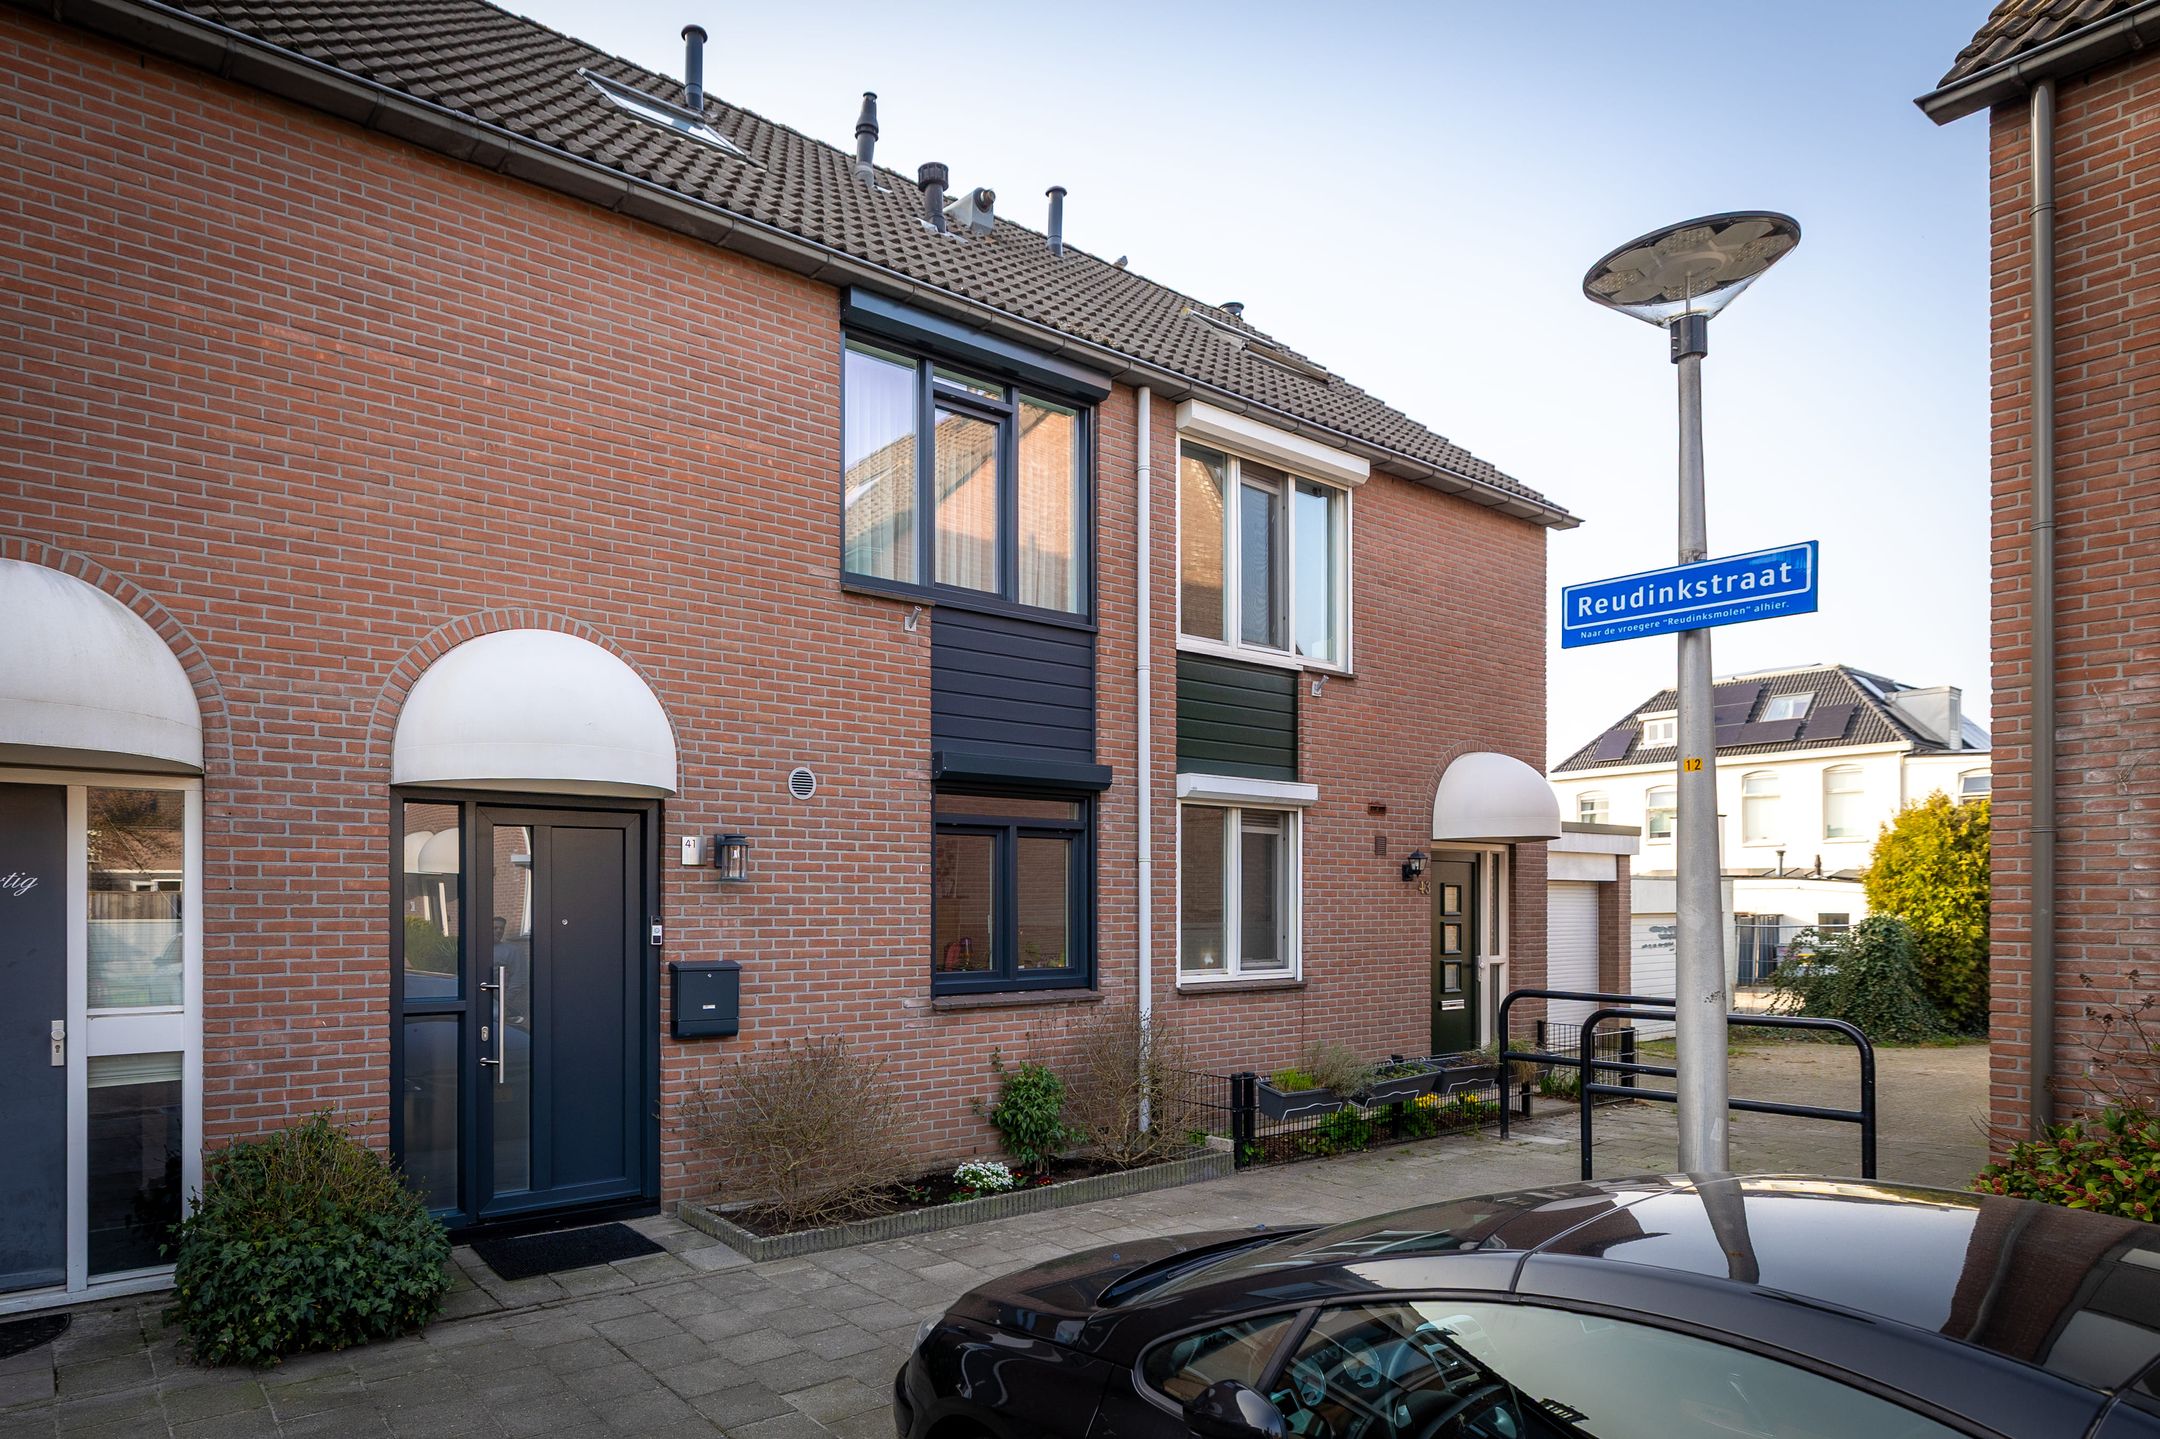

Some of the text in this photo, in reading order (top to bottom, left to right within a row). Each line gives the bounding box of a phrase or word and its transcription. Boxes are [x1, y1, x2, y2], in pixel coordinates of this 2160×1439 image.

[1578, 562, 1792, 618] Reudinkstraat
[1580, 630, 1602, 639] Naar
[1604, 625, 1615, 635] de
[1618, 621, 1660, 632] vroegere
[1753, 600, 1790, 613] alhier.
[685, 839, 696, 849] 41
[1418, 880, 1431, 895] 43
